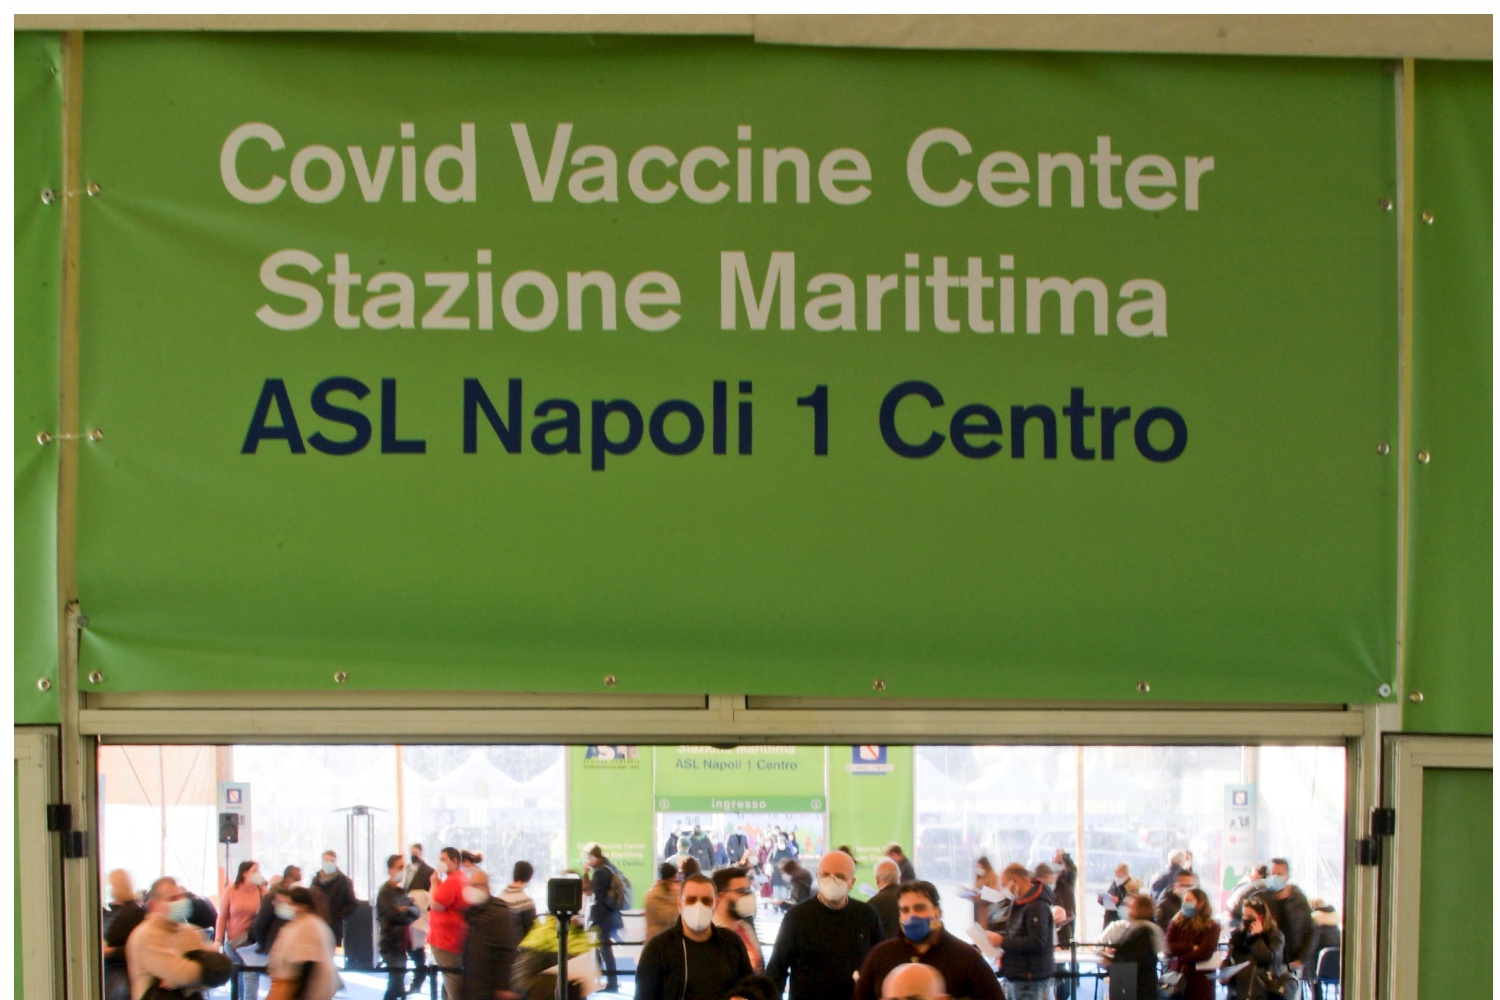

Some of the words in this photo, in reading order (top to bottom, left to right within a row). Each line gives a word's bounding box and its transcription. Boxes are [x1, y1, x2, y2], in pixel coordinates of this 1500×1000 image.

[218, 120, 477, 204] Covid
[509, 121, 873, 205] Vaccine
[906, 126, 1216, 211] Center
[255, 247, 682, 331] Stazione
[719, 249, 1169, 337] Marittima
[241, 376, 427, 456] ASL
[463, 378, 753, 472] Napoli
[796, 384, 832, 456] 1
[878, 380, 1188, 463] Centro
[675, 759, 699, 770] ASL
[703, 759, 742, 772] Napoli
[756, 760, 798, 771] Centro
